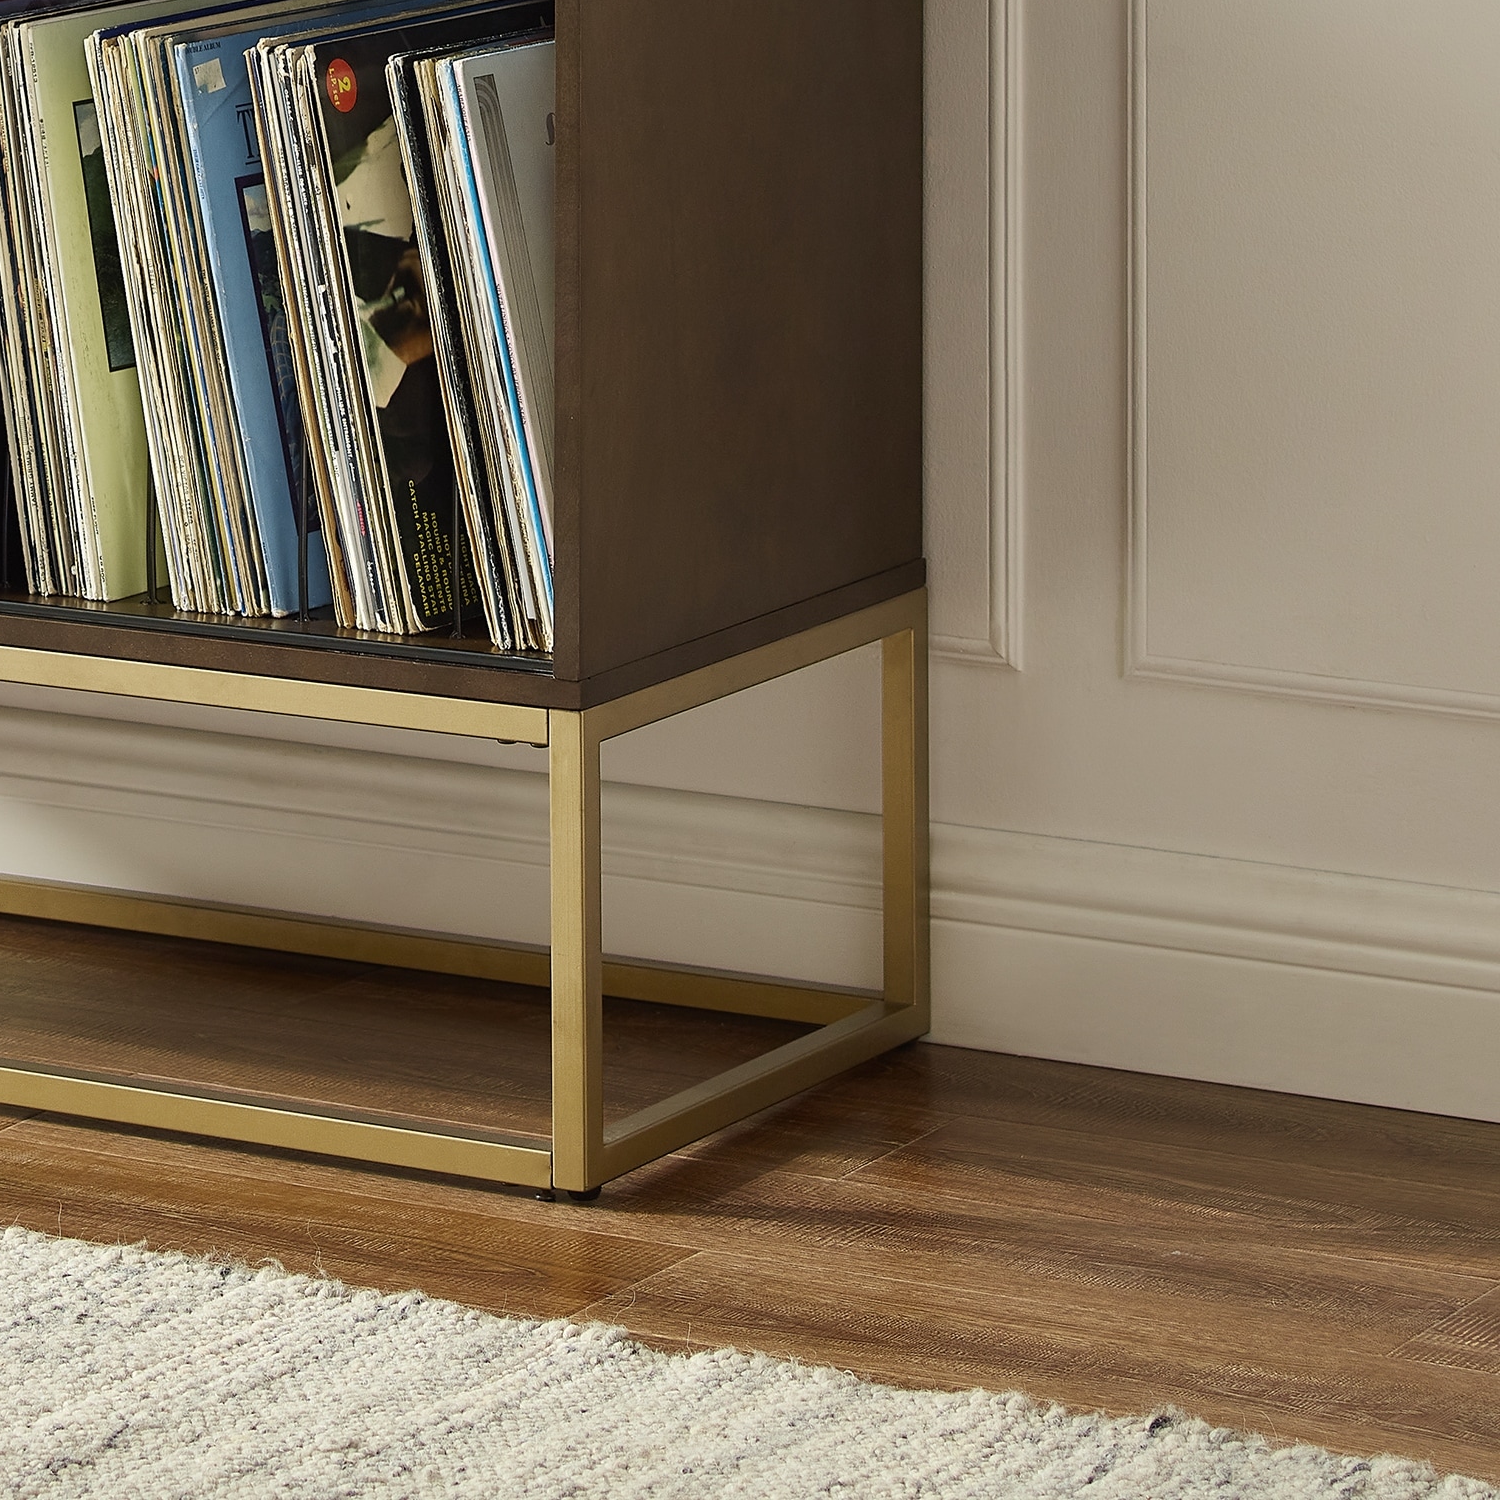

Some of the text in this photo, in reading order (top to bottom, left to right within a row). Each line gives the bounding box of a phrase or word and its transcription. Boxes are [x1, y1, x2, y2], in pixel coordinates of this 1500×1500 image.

[328, 67, 337, 87] L.P.
[337, 76, 351, 93] 2
[408, 479, 439, 616] CATCH A FALLING STAR
[430, 512, 442, 554] ROUND
[442, 534, 452, 557] HOT
[422, 511, 447, 613] MAGIC MOMENTS
[413, 553, 431, 618] DELAWARE
[466, 572, 479, 603] BACK
